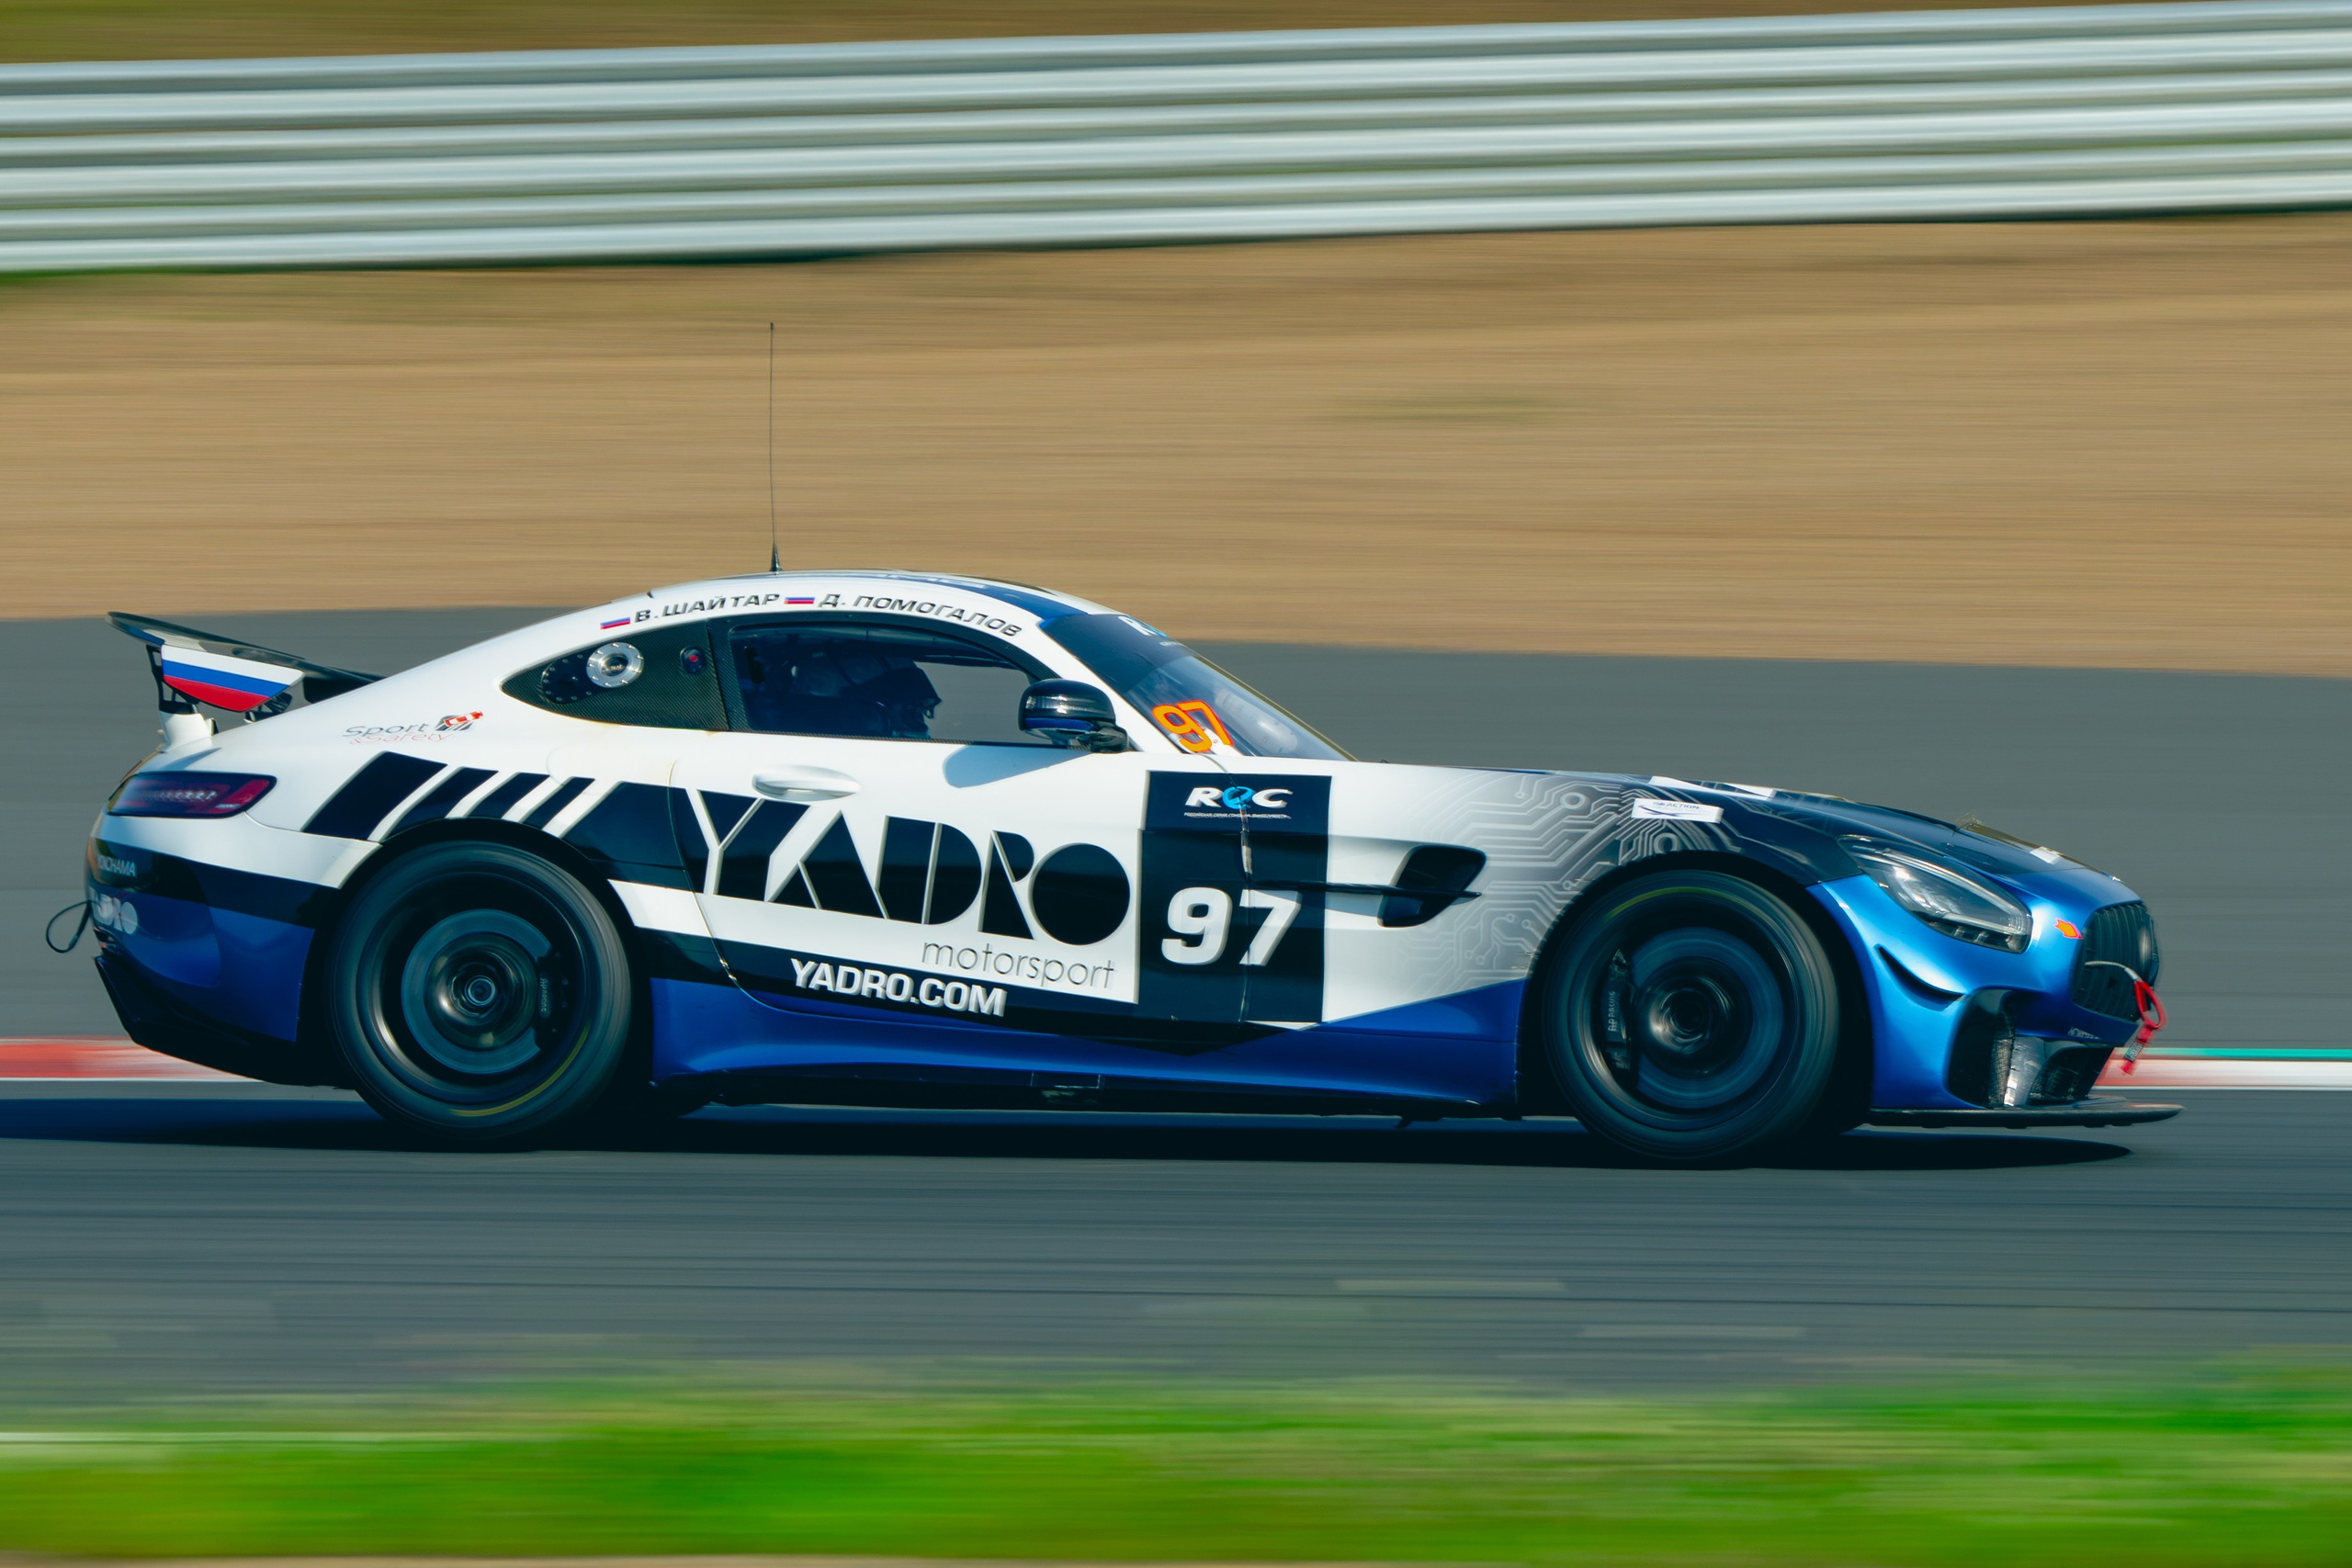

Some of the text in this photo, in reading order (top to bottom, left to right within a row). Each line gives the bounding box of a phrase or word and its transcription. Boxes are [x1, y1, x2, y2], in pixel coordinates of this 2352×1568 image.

[853, 595, 1023, 637] ПОМОГАЛОВ
[342, 723, 429, 737] Sport
[1152, 700, 1235, 752] 97
[696, 789, 1132, 946] YADRO
[1161, 886, 1303, 966] 97
[791, 958, 1008, 1017] YADRO.COM
[921, 941, 1114, 988] motorsport
